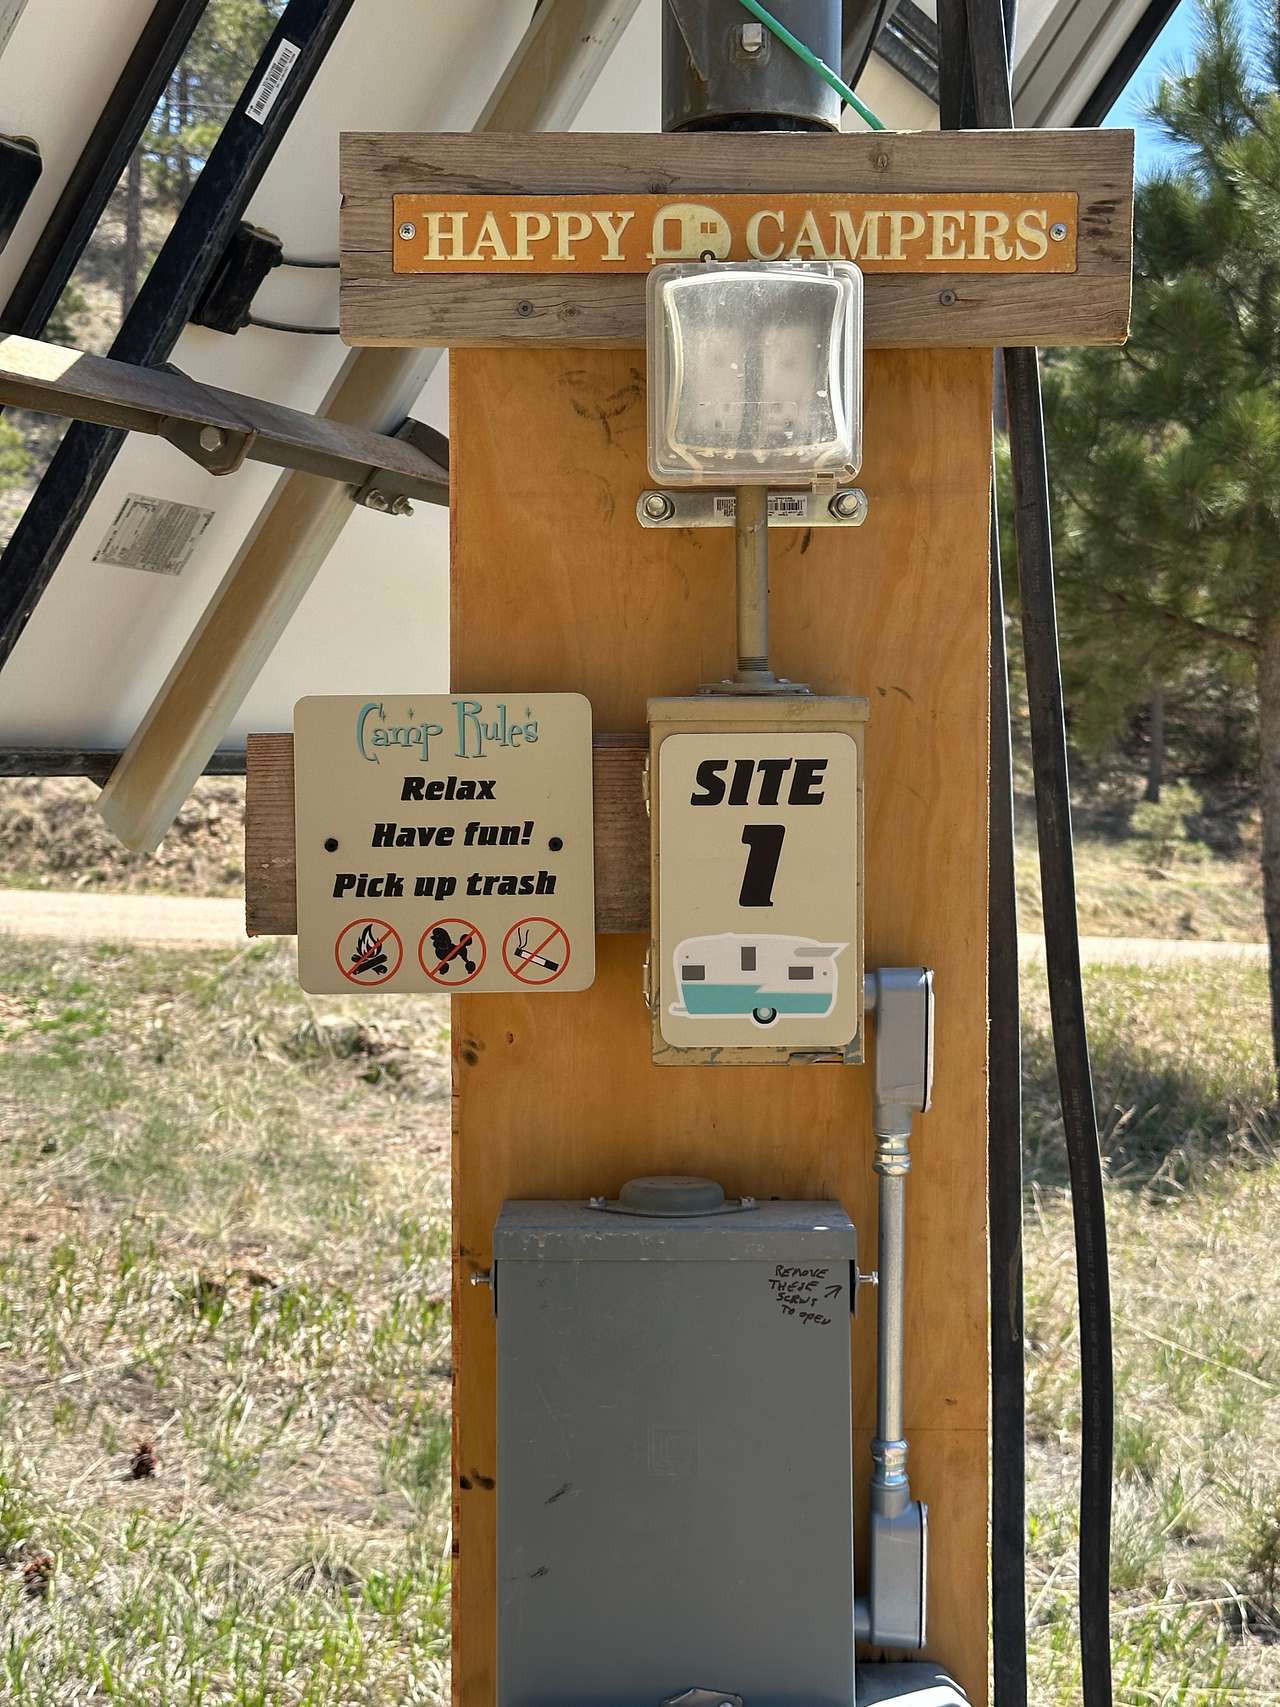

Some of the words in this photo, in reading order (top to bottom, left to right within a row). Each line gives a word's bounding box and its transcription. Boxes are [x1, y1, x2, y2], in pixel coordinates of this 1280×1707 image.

[422, 211, 635, 261] HAPPY
[745, 209, 1049, 261] CAMPERS
[356, 702, 443, 765] Camp
[451, 700, 539, 759] Rules
[400, 776, 497, 801] Relax
[690, 758, 829, 806] SITE
[371, 822, 456, 848] Have
[463, 821, 535, 846] fun!
[738, 824, 786, 907] 1
[332, 872, 405, 898] Pick
[413, 876, 457, 900] up
[466, 870, 557, 896] trash
[768, 1279, 819, 1292] THESE
[775, 1264, 829, 1279] REMOVE
